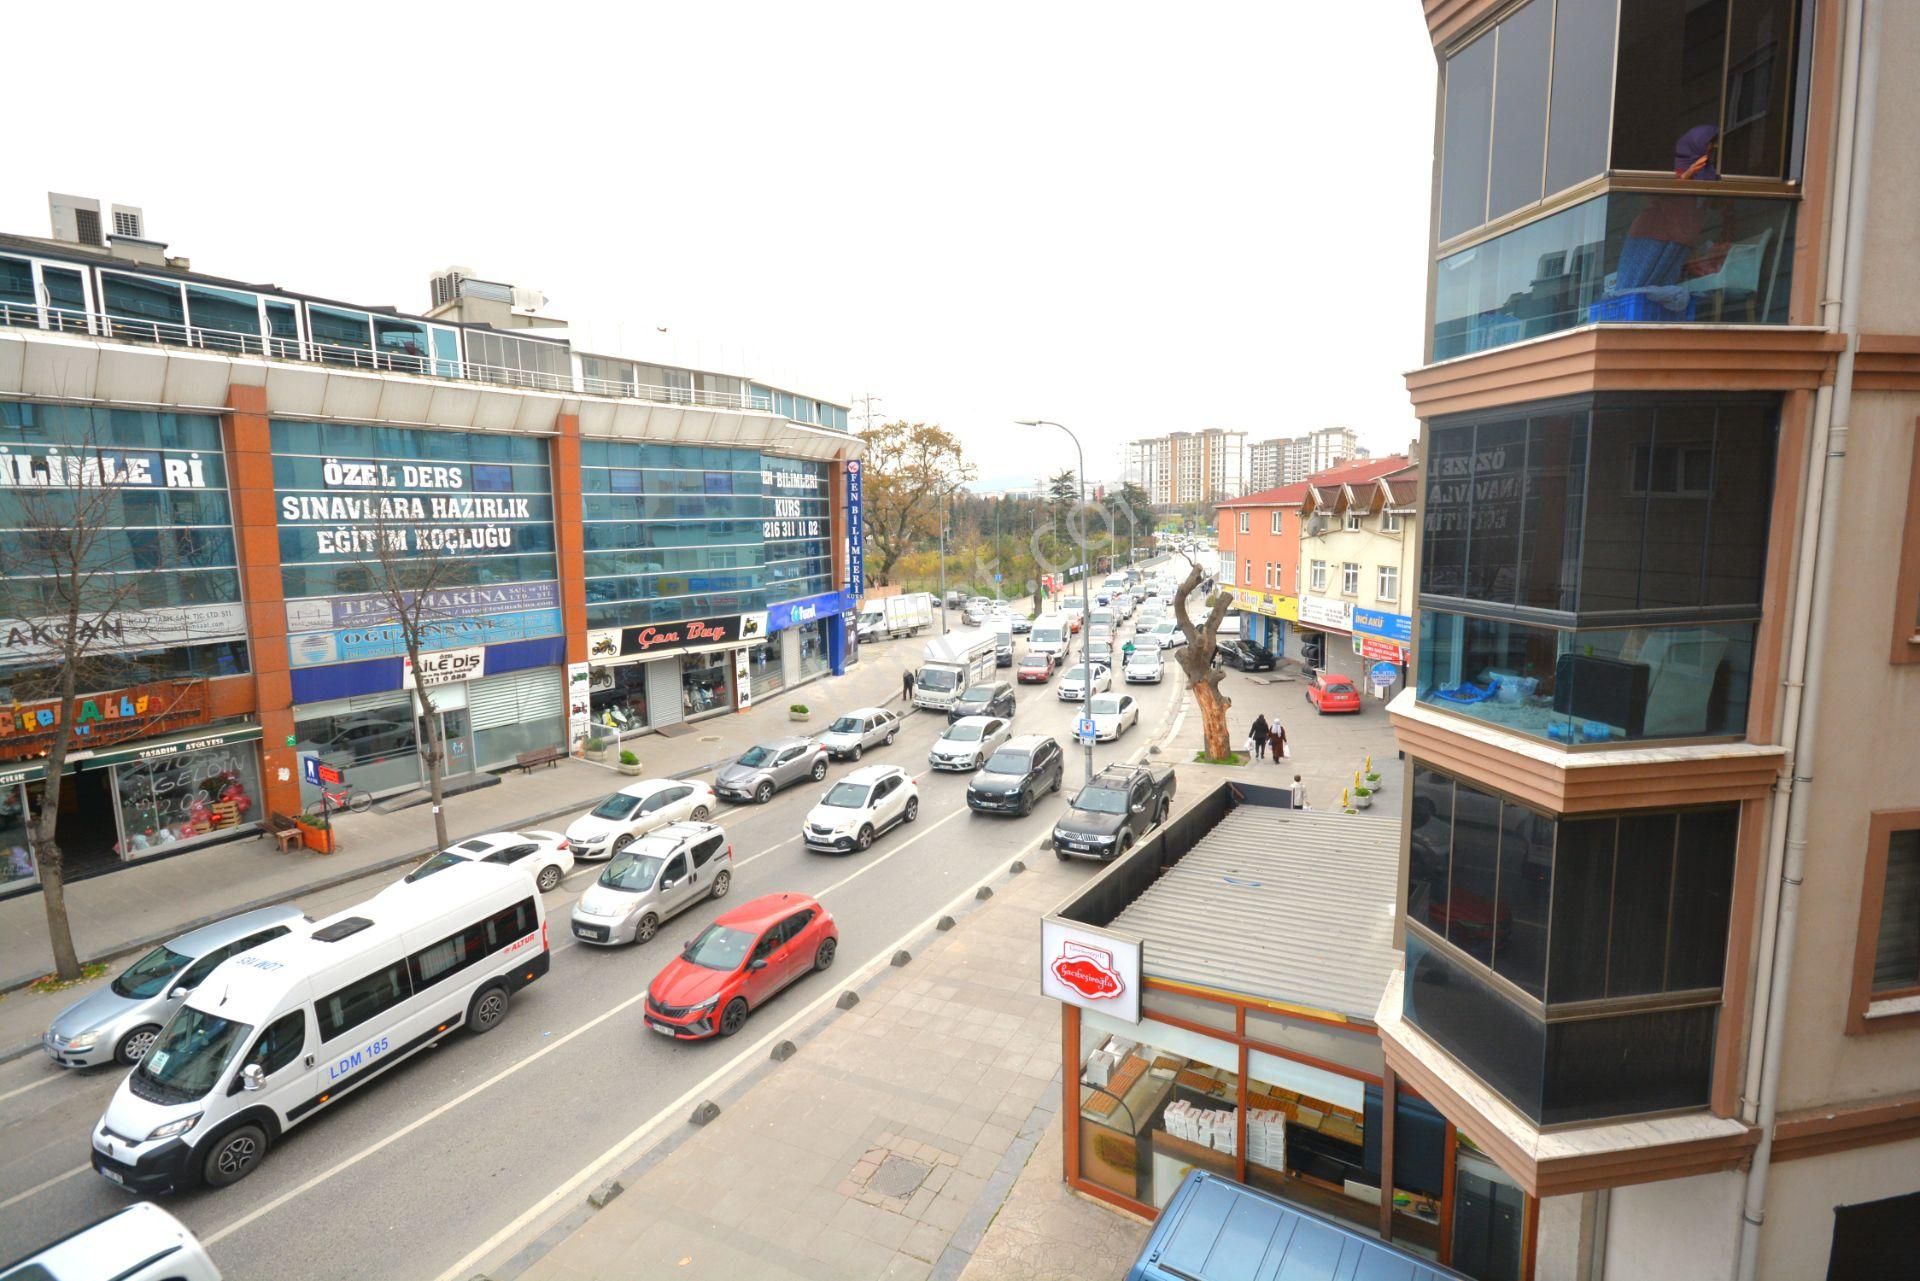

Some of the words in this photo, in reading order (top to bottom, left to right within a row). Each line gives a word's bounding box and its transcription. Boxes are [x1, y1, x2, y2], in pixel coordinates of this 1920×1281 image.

[323, 458, 396, 488] ÖZEL
[402, 464, 463, 489] DERS
[777, 468, 818, 489] BİLİMLERİ
[849, 473, 860, 501] FEN
[282, 496, 425, 520] SINAVLARA
[431, 497, 530, 520] HAZIRLIK
[775, 499, 800, 517] KURS
[316, 525, 408, 554] EĞİTİM
[415, 523, 512, 555] KOÇLUĞU
[782, 520, 795, 537] 311
[798, 521, 806, 537] 11
[808, 520, 818, 536] 02
[850, 505, 863, 594] BİLİMLERİ
[416, 588, 507, 612] MAKİNA
[453, 654, 480, 669] DİŞ
[139, 745, 177, 759] TASARIM
[512, 933, 535, 952] ALTUR
[330, 1051, 363, 1080] LDM
[366, 1036, 389, 1058] 185
